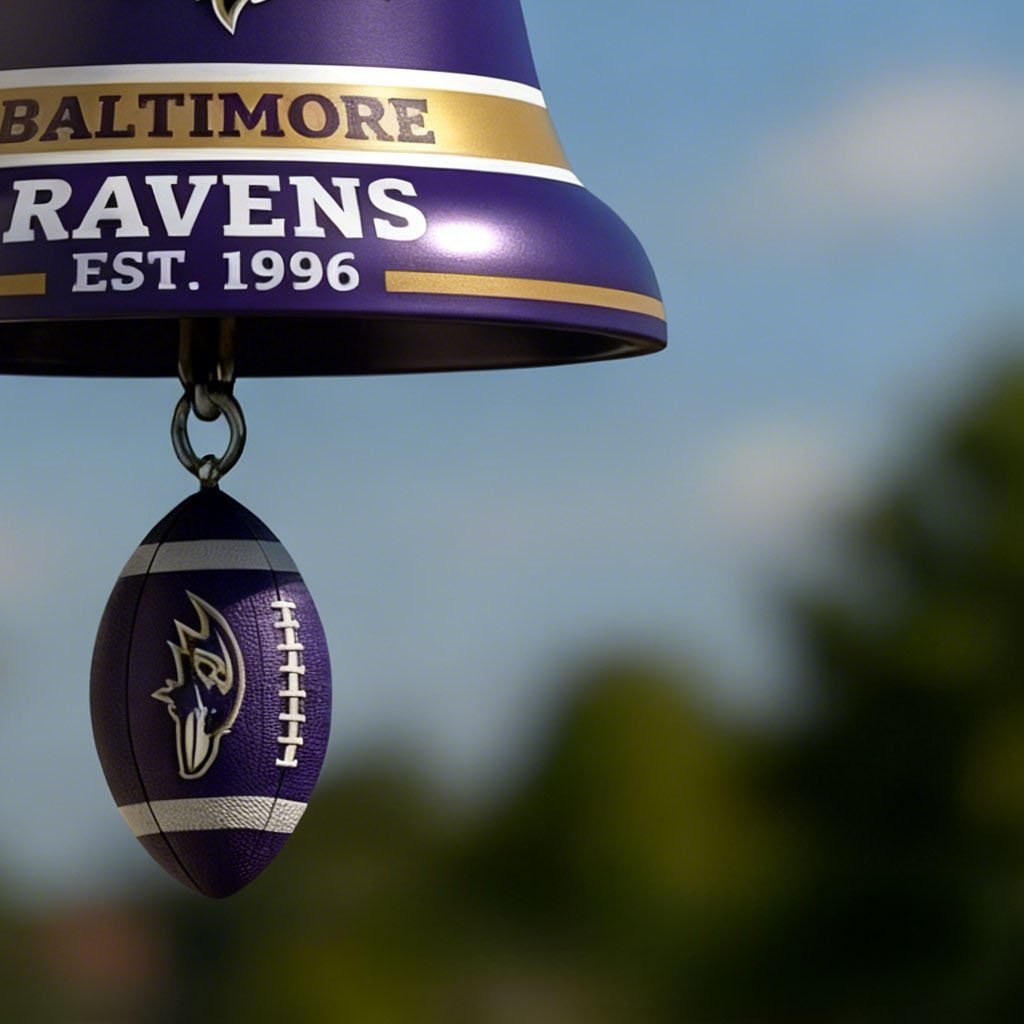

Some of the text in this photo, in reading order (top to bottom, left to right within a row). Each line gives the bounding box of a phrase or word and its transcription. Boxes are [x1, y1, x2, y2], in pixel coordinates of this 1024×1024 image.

[2, 174, 428, 244] RAVENS
[72, 250, 360, 292] EST. 1996
